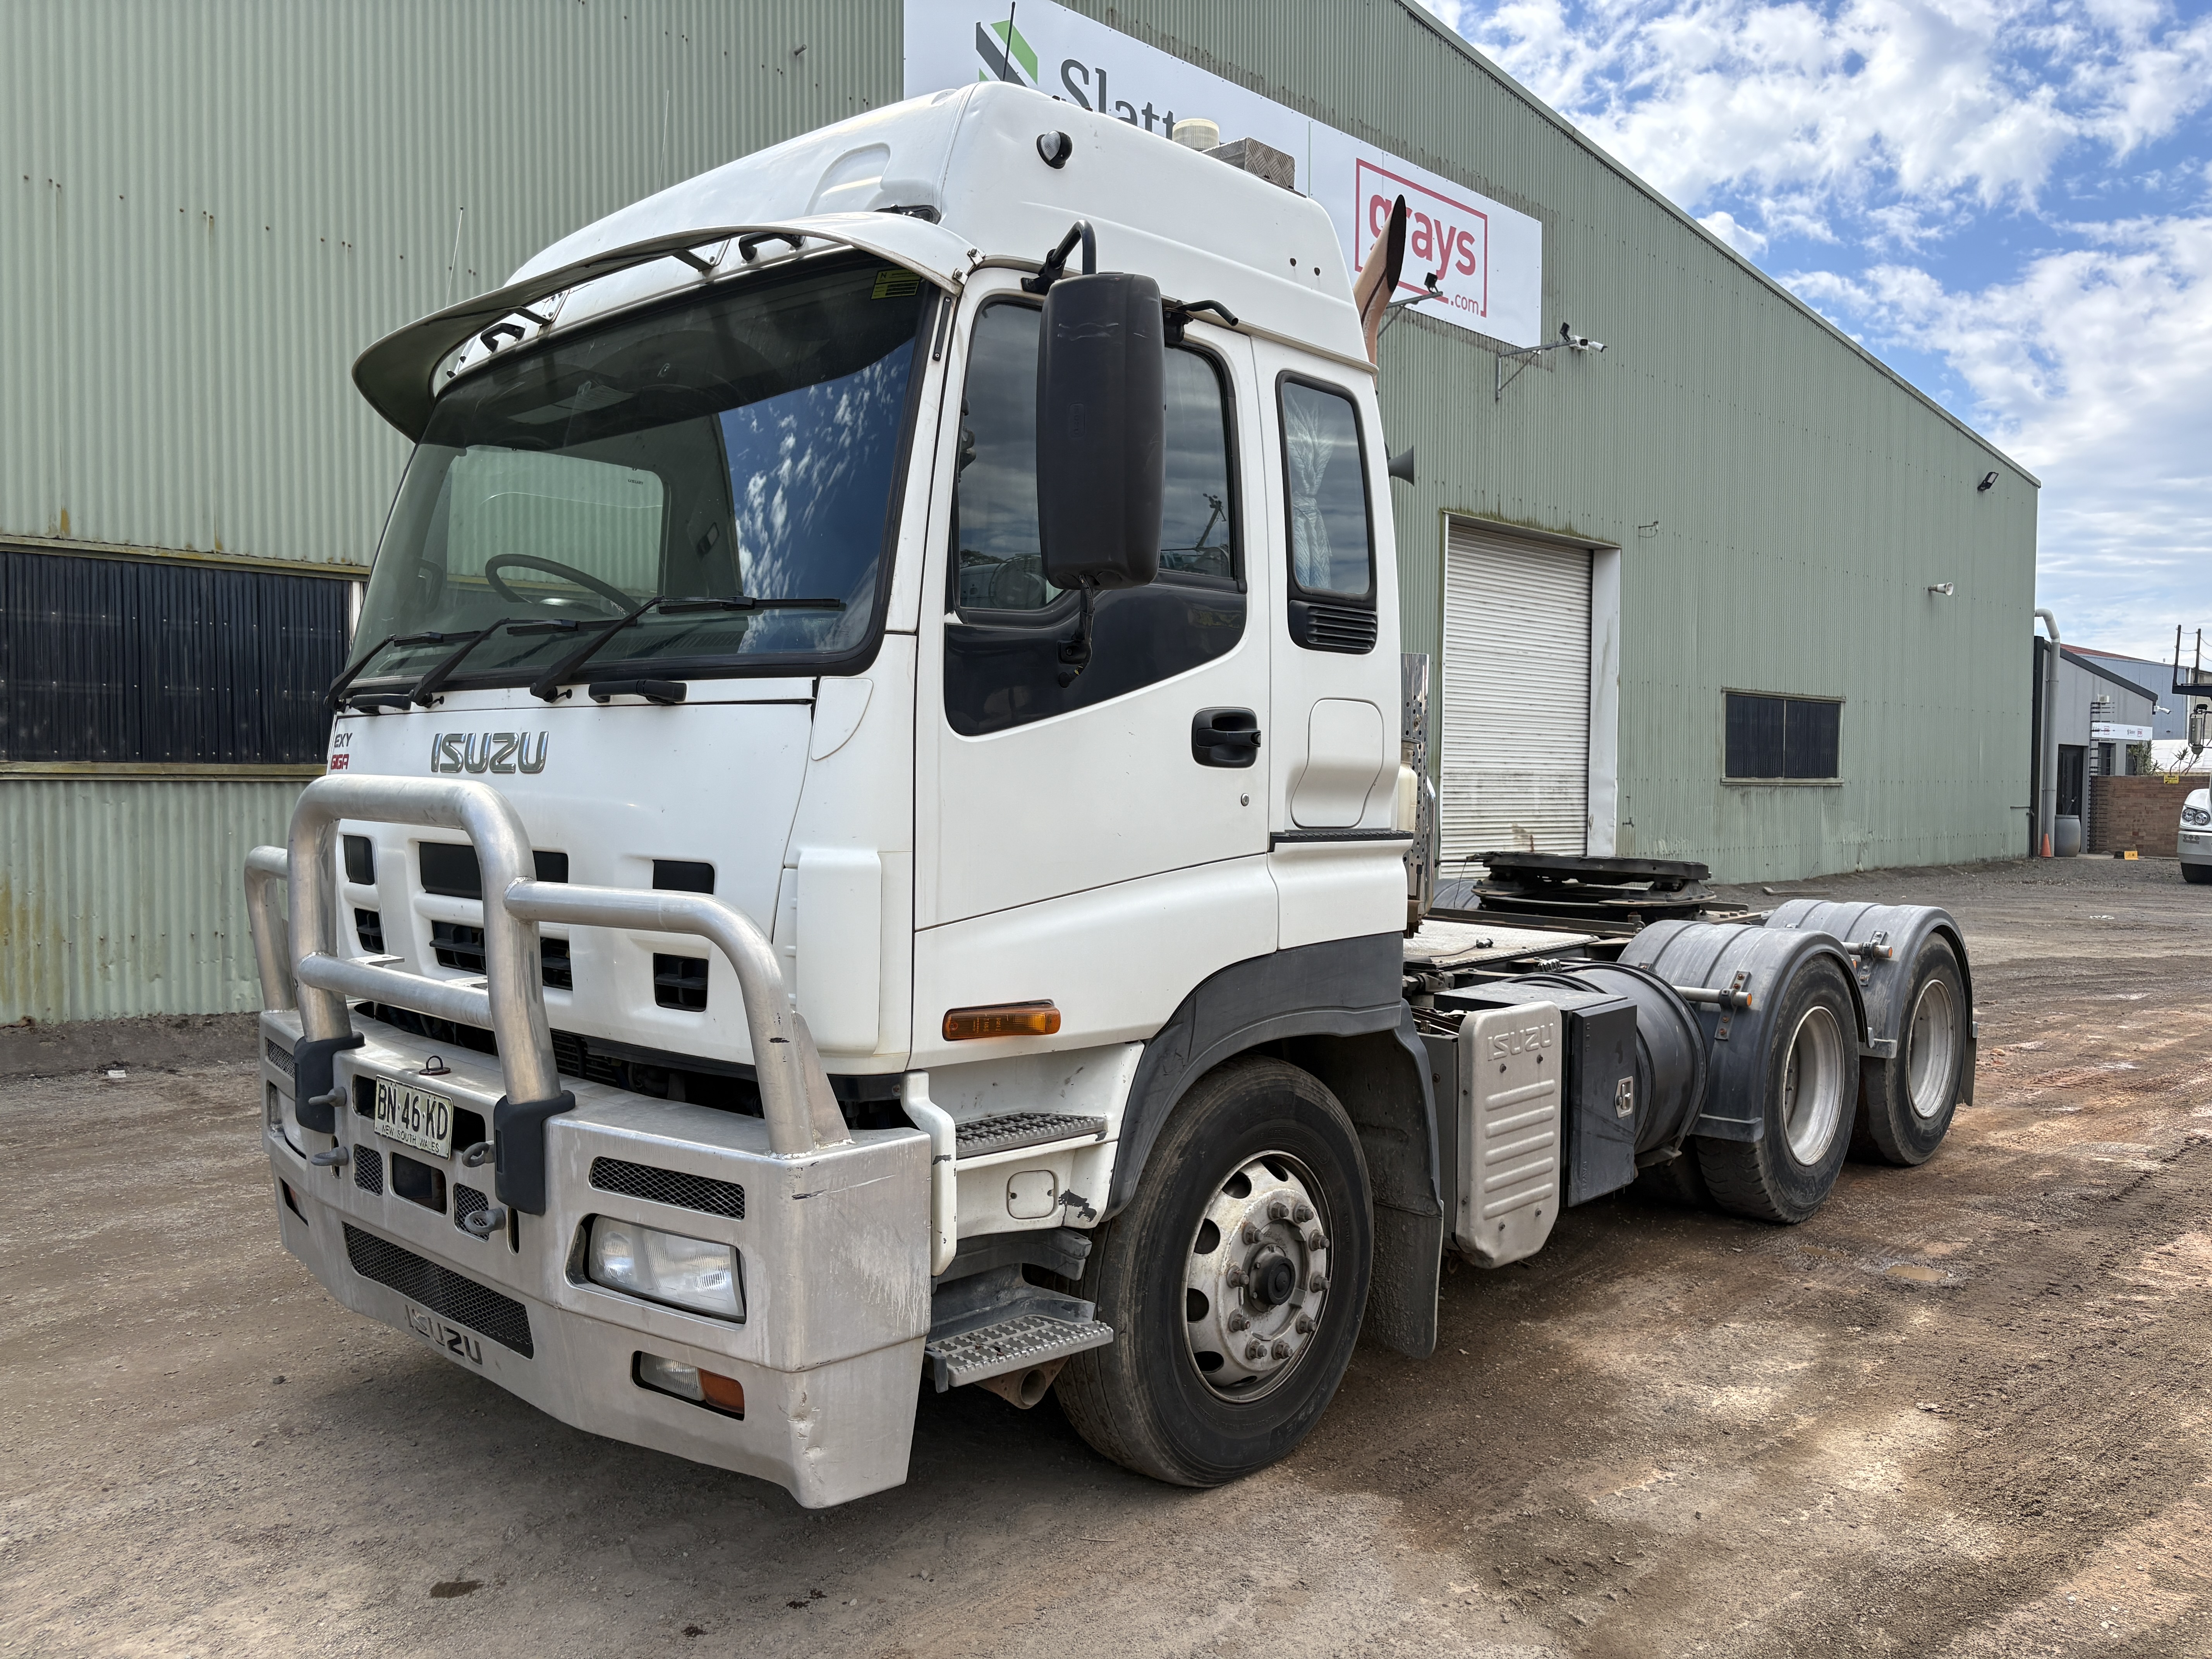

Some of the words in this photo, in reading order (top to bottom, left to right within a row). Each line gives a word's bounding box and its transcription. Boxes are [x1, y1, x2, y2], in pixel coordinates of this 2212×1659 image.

[1451, 294, 1479, 315] .com
[334, 733, 353, 747] EXY
[431, 731, 549, 774] ISUZU
[331, 754, 349, 769] GIGA
[1487, 1023, 1554, 1061] ISUZU
[382, 1124, 394, 1136] NEW
[397, 1130, 417, 1145] SOUTH
[420, 1137, 440, 1153] WALES
[405, 1304, 483, 1365] ISUZU
